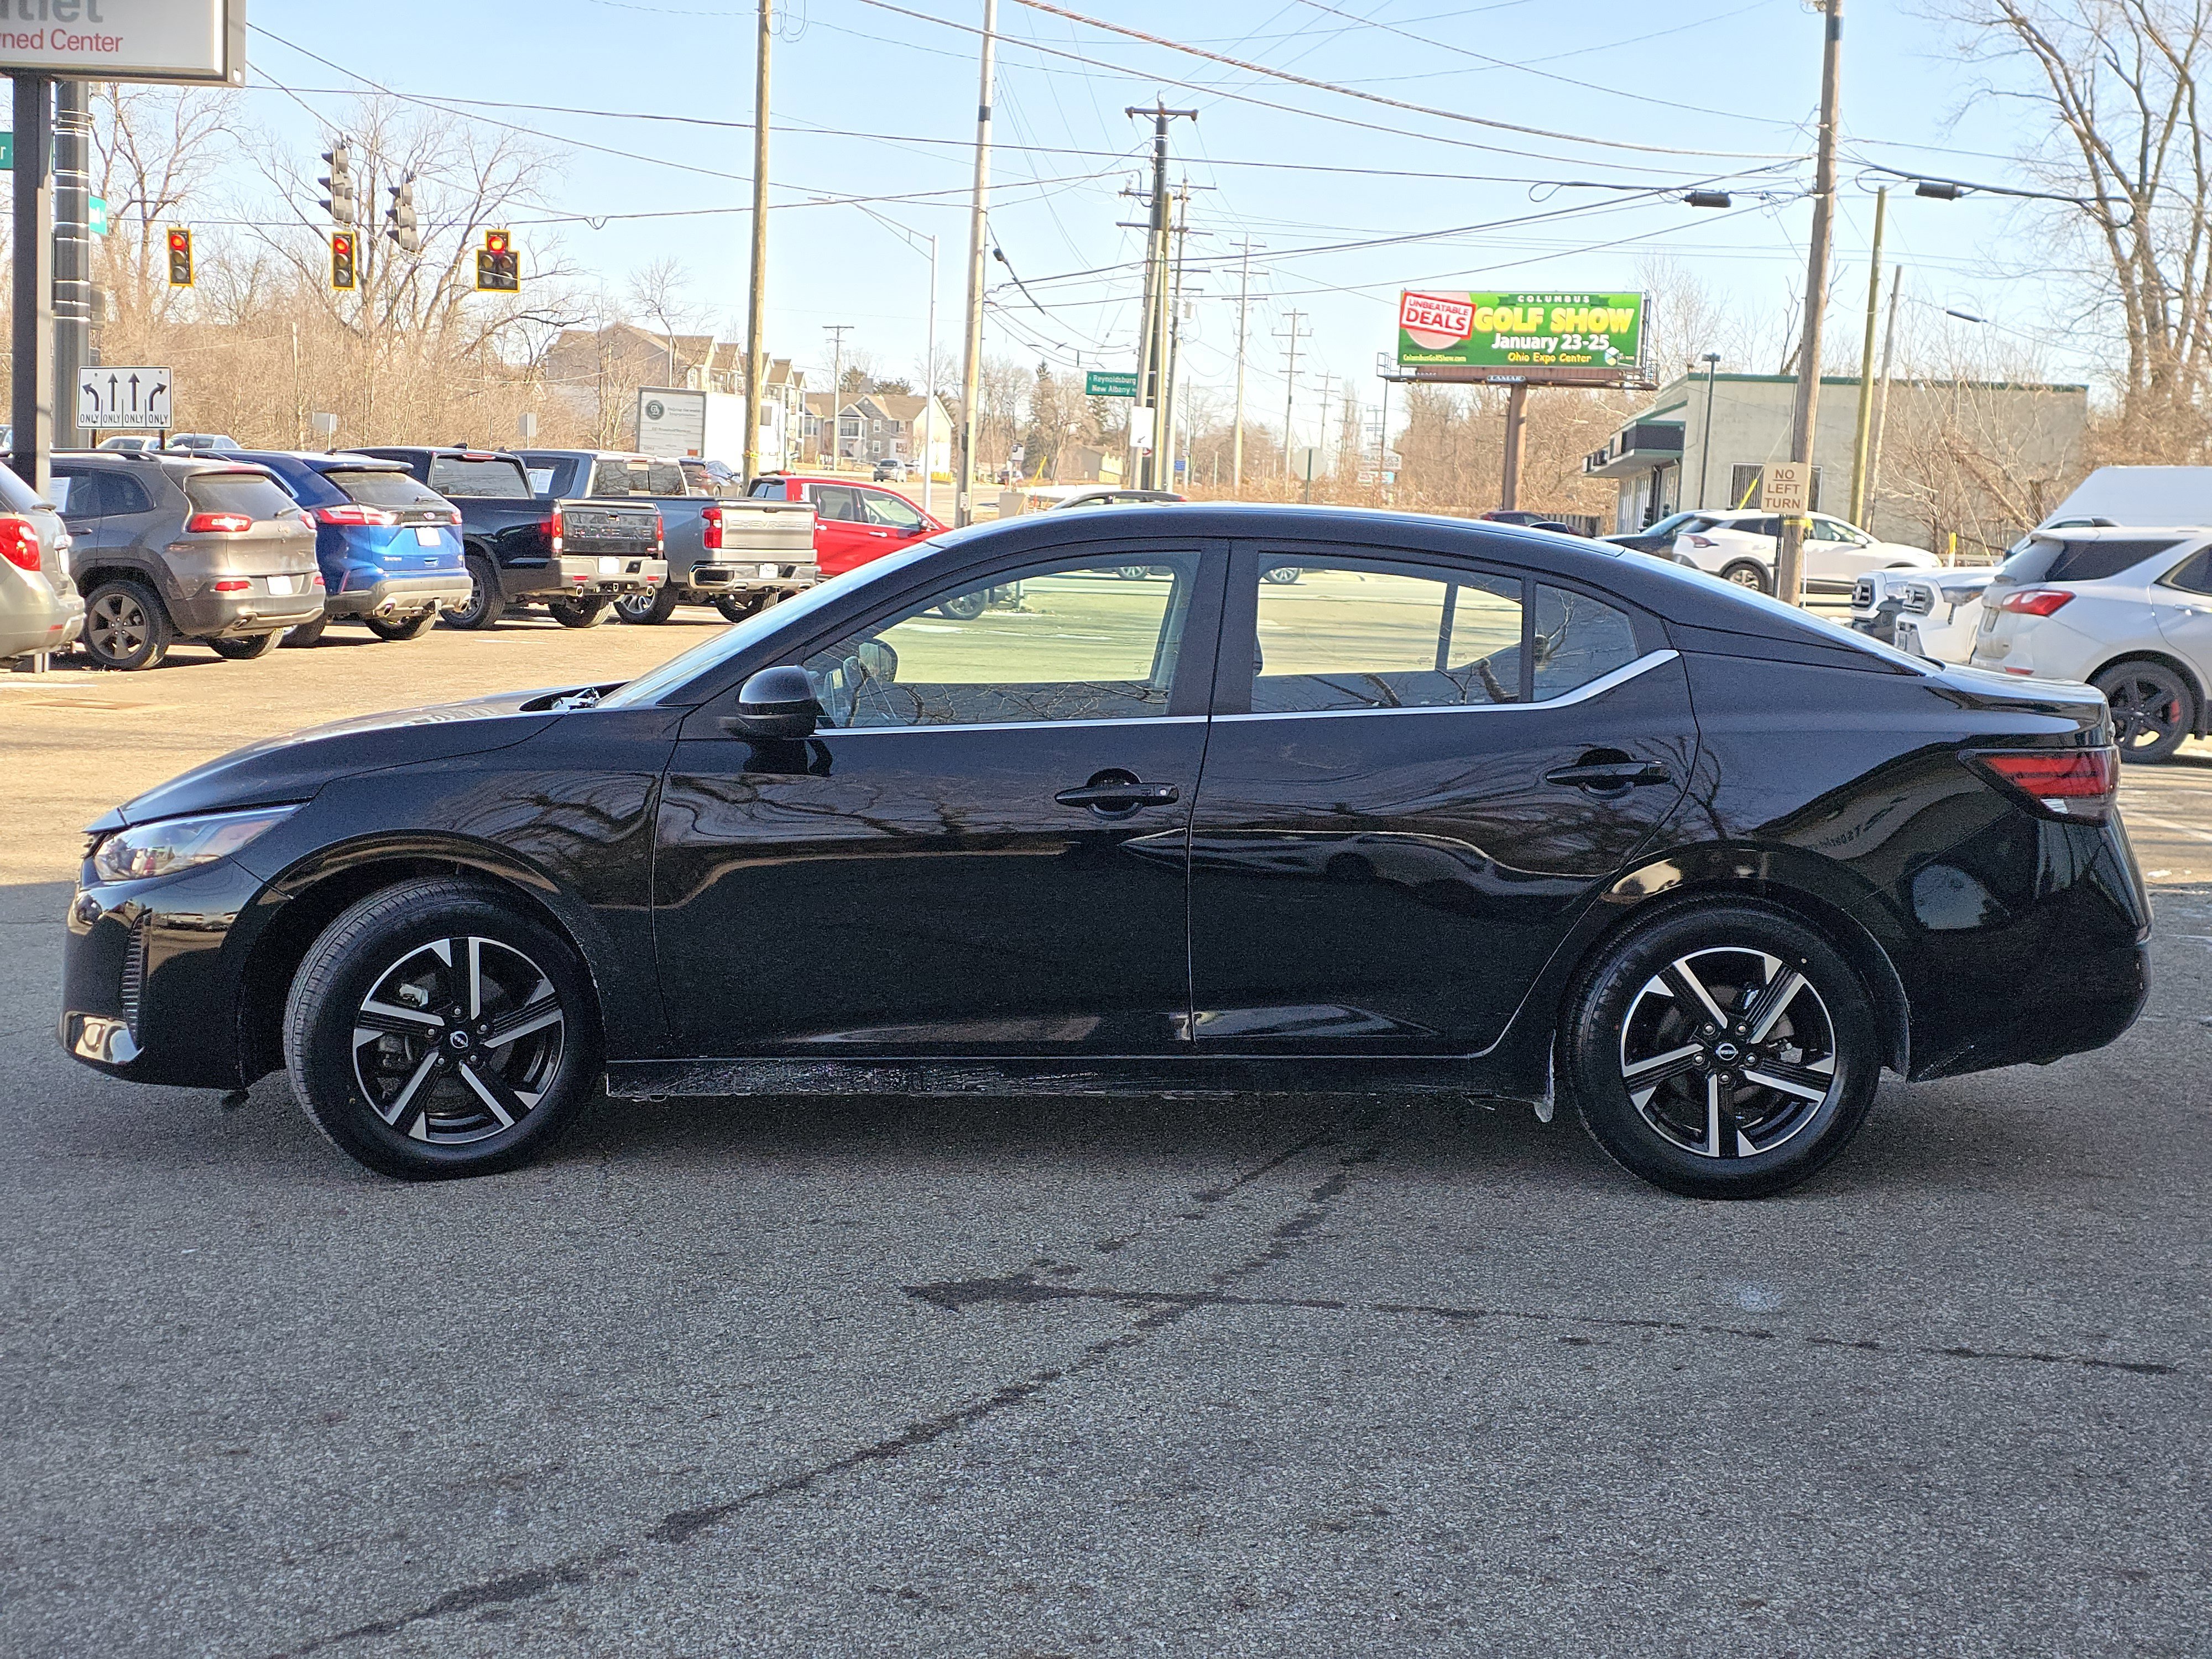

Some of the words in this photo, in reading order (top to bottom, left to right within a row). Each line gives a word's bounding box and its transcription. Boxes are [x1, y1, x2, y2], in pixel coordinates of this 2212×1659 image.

[0, 28, 44, 50] ned
[50, 29, 123, 52] Center
[1517, 295, 1590, 303] COLUMBUS
[1408, 299, 1469, 315] UNBEATABLE
[1406, 307, 1467, 331] DEALS
[1473, 306, 1545, 332] GOLF
[1550, 307, 1635, 333] SHOW
[1491, 333, 1559, 353] January
[1561, 333, 1610, 350] 23-25
[1507, 352, 1530, 362] Ohio
[1533, 352, 1557, 364] Expo
[1559, 353, 1592, 363] Center
[1108, 385, 1131, 395] Albany
[80, 414, 100, 424] ONLY
[103, 414, 121, 424] ONLY
[124, 414, 144, 424] ONLY
[148, 414, 169, 425] ONLY
[1775, 468, 1795, 479] NO
[1767, 483, 1801, 494] LEFT
[1764, 497, 1801, 509] TURN
